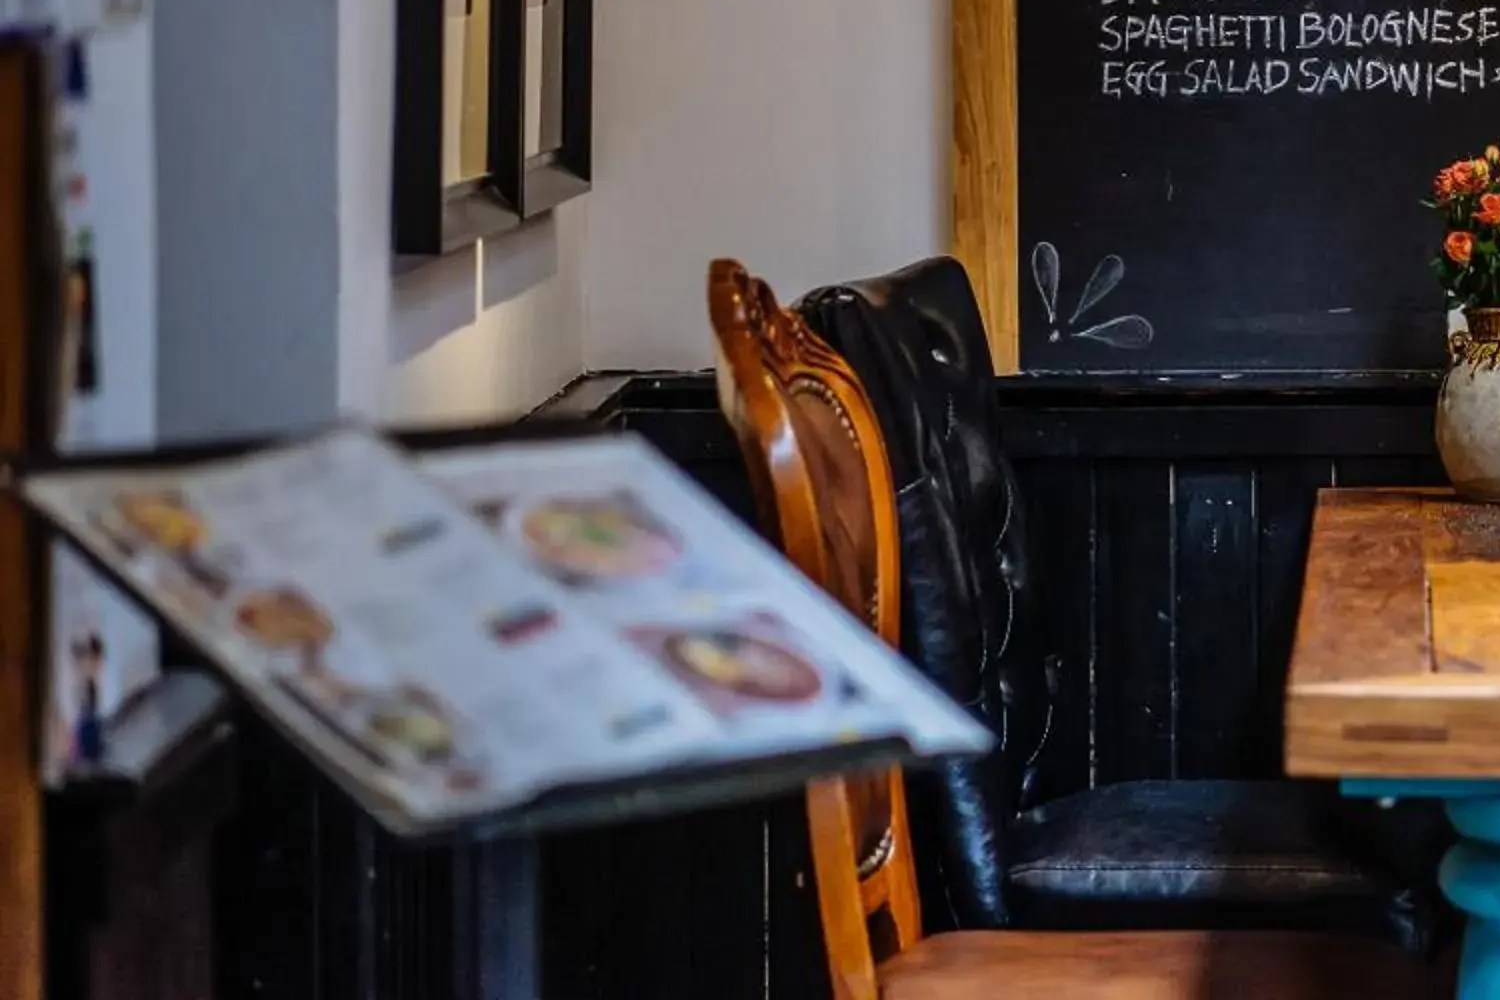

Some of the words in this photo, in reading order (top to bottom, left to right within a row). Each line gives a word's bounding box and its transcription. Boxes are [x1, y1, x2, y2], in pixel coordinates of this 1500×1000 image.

[1098, 14, 1285, 51] SPAGHETTI
[1295, 7, 1500, 49] BOLOGNESE
[1102, 60, 1167, 98] EGG
[1179, 59, 1290, 96] SALAD
[1296, 56, 1485, 100] SANDWICH
